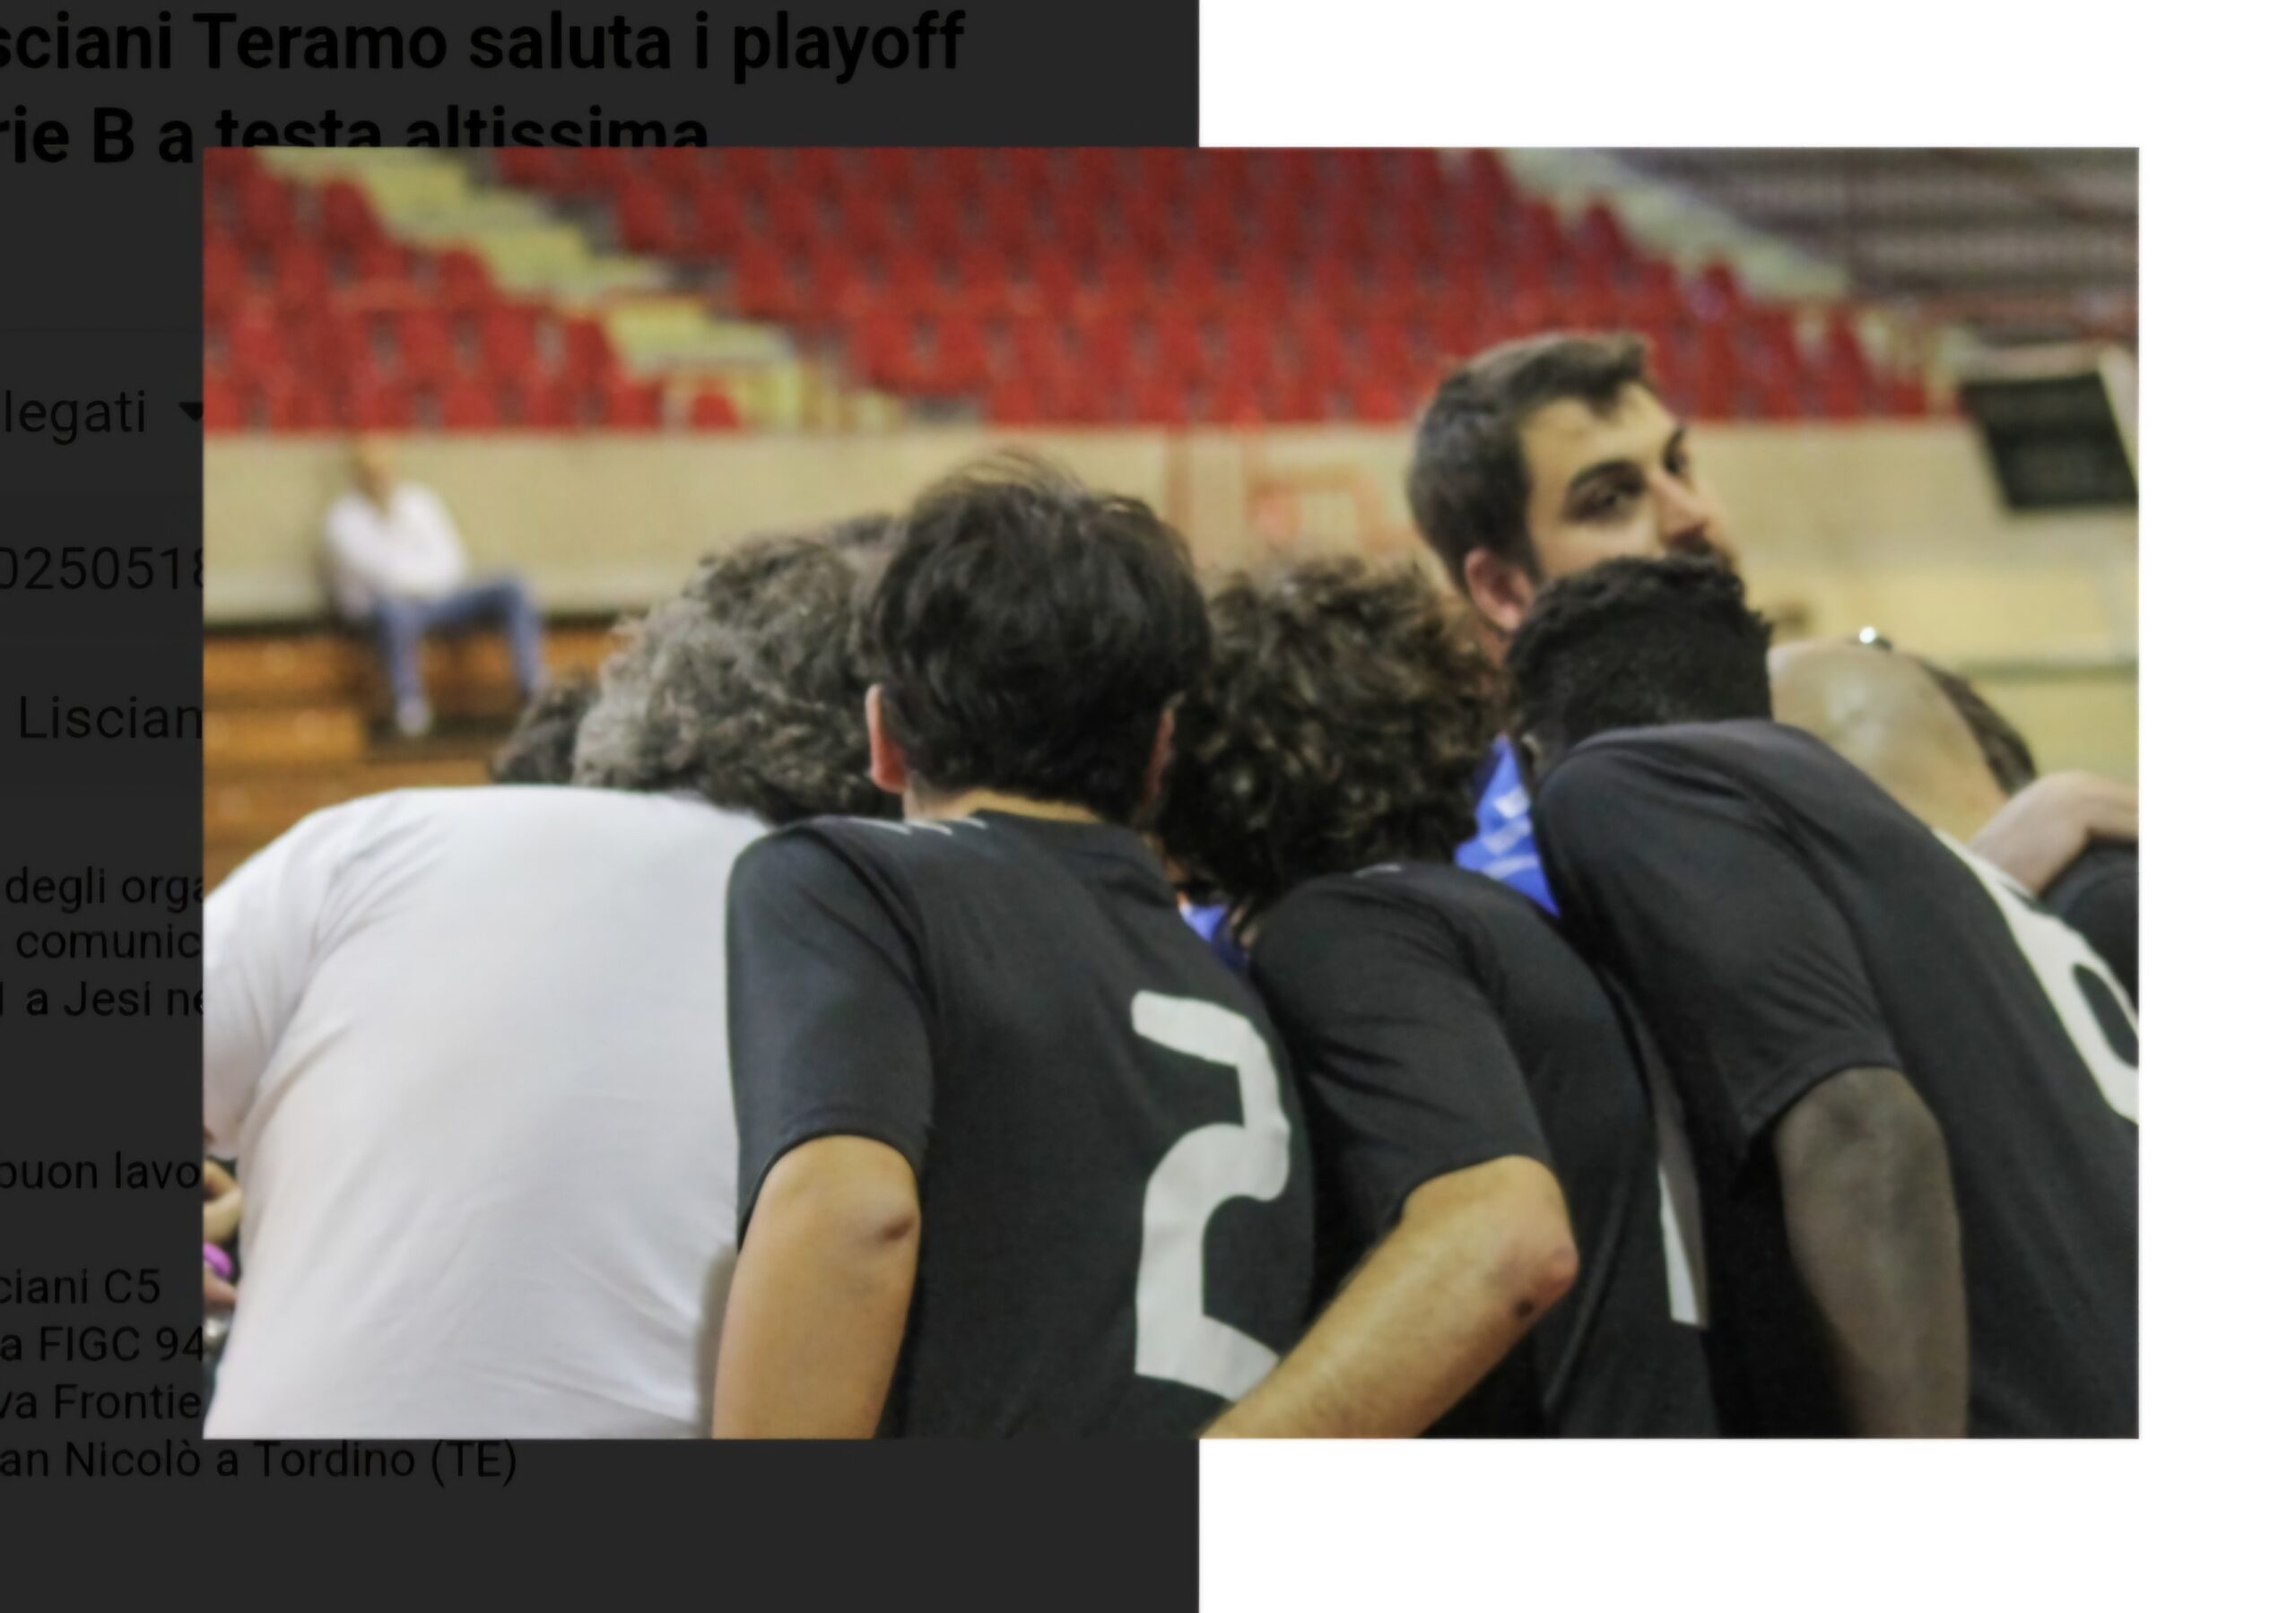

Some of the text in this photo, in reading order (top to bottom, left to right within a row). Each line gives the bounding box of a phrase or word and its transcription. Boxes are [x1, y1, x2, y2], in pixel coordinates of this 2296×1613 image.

[192, 13, 448, 70] Teramo
[469, 10, 671, 70] saluta
[695, 10, 709, 70] i
[734, 9, 967, 83] playoff
[93, 107, 135, 163] B
[158, 119, 194, 164] a
[214, 108, 381, 146] testa
[406, 104, 708, 146] altissima
[5, 389, 145, 446] legati
[5, 865, 105, 914] degli
[16, 924, 200, 958] comunic
[26, 988, 48, 1017] a
[64, 981, 151, 1017] Jesi
[115, 1150, 201, 1190] lavo
[104, 1269, 161, 1304] C5
[0, 1325, 202, 1362] a FIGC 94
[55, 1383, 201, 1419] Frontie
[65, 1439, 201, 1478] Nicolò
[216, 1449, 239, 1477] a
[253, 1440, 415, 1478] Tordino
[431, 1440, 517, 1488] (TE)
